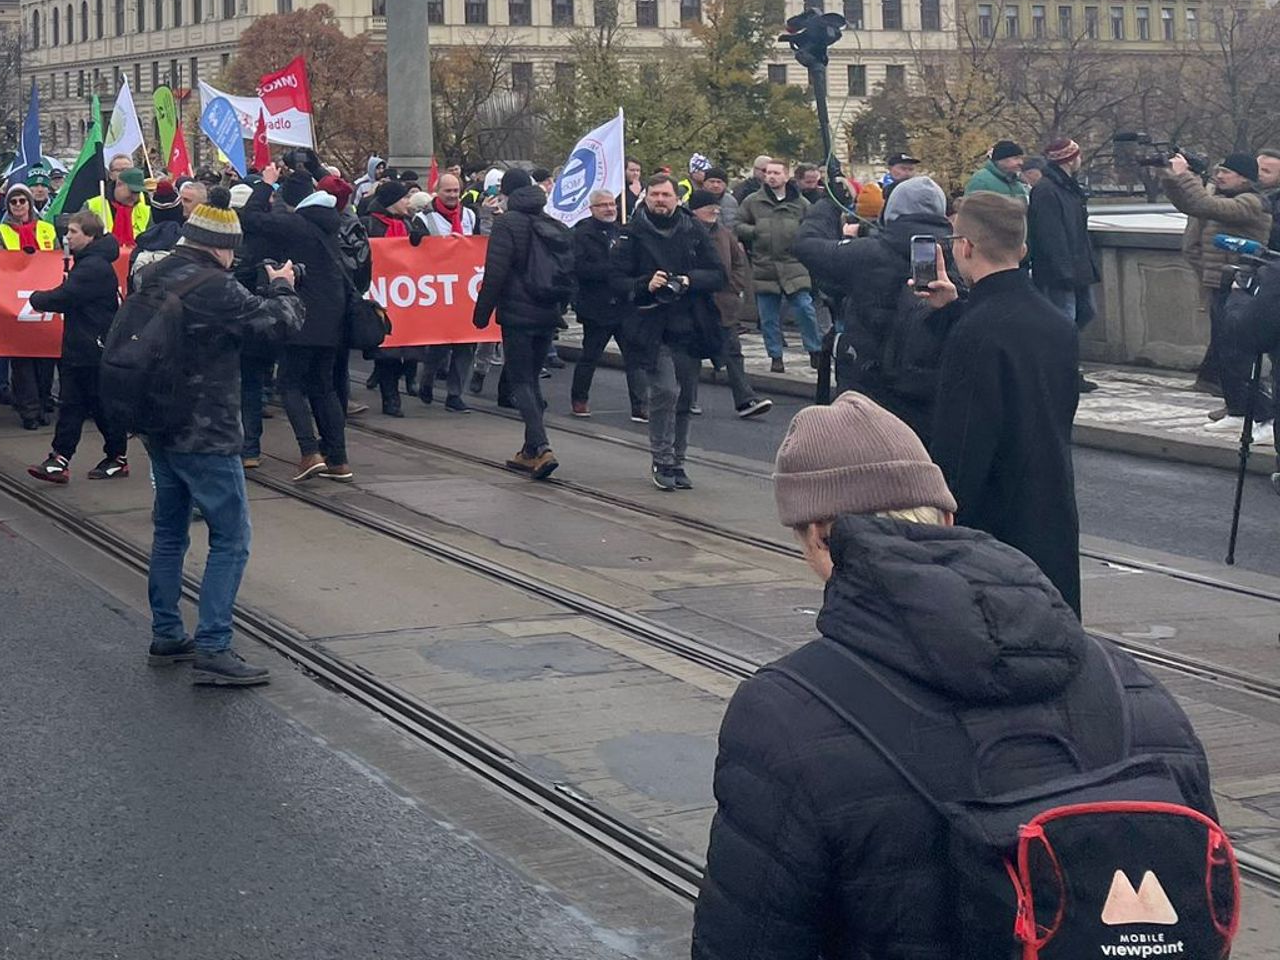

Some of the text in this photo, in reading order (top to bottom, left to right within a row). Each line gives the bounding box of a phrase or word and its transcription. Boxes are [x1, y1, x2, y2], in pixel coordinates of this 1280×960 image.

[363, 266, 486, 308] NOST Č
[1120, 933, 1164, 943] MOBILE
[1100, 940, 1184, 958] viewpoint
